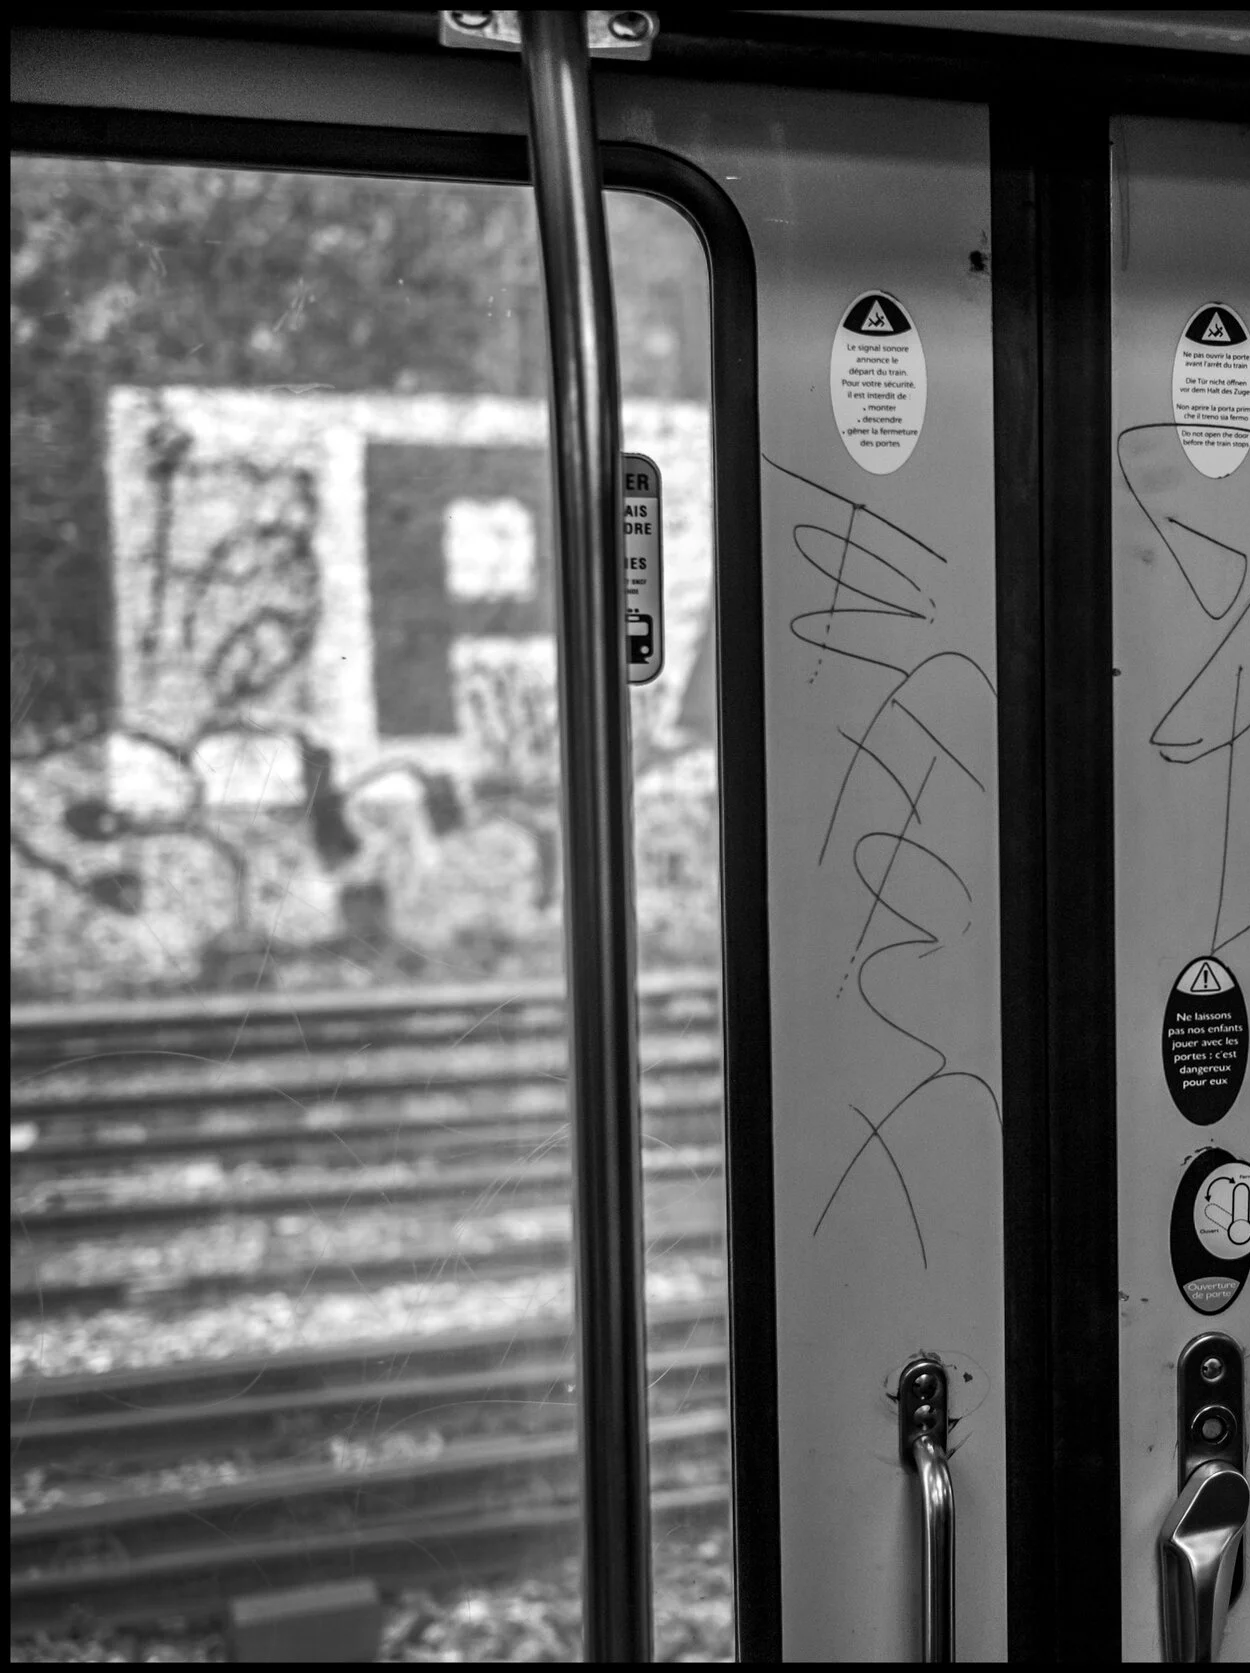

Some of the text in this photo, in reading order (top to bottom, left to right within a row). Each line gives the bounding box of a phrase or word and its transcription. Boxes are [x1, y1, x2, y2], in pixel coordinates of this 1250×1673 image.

[858, 344, 881, 353] signal
[892, 356, 899, 364] le
[1233, 354, 1250, 362] porte
[849, 368, 875, 377] départ
[877, 368, 887, 376] du
[842, 379, 860, 387] Pour
[1209, 378, 1225, 386] nicht
[1227, 379, 1247, 387] öffnen
[848, 391, 852, 399] il
[867, 392, 896, 400] interdit
[868, 404, 897, 412] monter
[1191, 405, 1210, 413] aprire
[1218, 406, 1235, 414] porta
[862, 416, 902, 424] descendre
[1230, 414, 1249, 422] fermo
[848, 428, 870, 436] gêner
[880, 428, 918, 436] fermeture
[1205, 432, 1221, 440] open
[625, 473, 649, 490] ER
[624, 505, 648, 517] AIS
[624, 522, 652, 535] DRE
[624, 557, 647, 570] IES
[1177, 1012, 1232, 1022] Ne laissons
[1168, 1028, 1185, 1037] pas
[1208, 1024, 1243, 1033] enfants
[1172, 1040, 1198, 1050] jouer
[1226, 1037, 1239, 1046] les
[1174, 1052, 1207, 1063] portes
[1215, 1050, 1237, 1059] c'est
[1180, 1064, 1231, 1075] dangereux
[1183, 1078, 1207, 1089] pour
[1188, 1282, 1237, 1292] Ouverture
[1192, 1291, 1231, 1301] de porte
